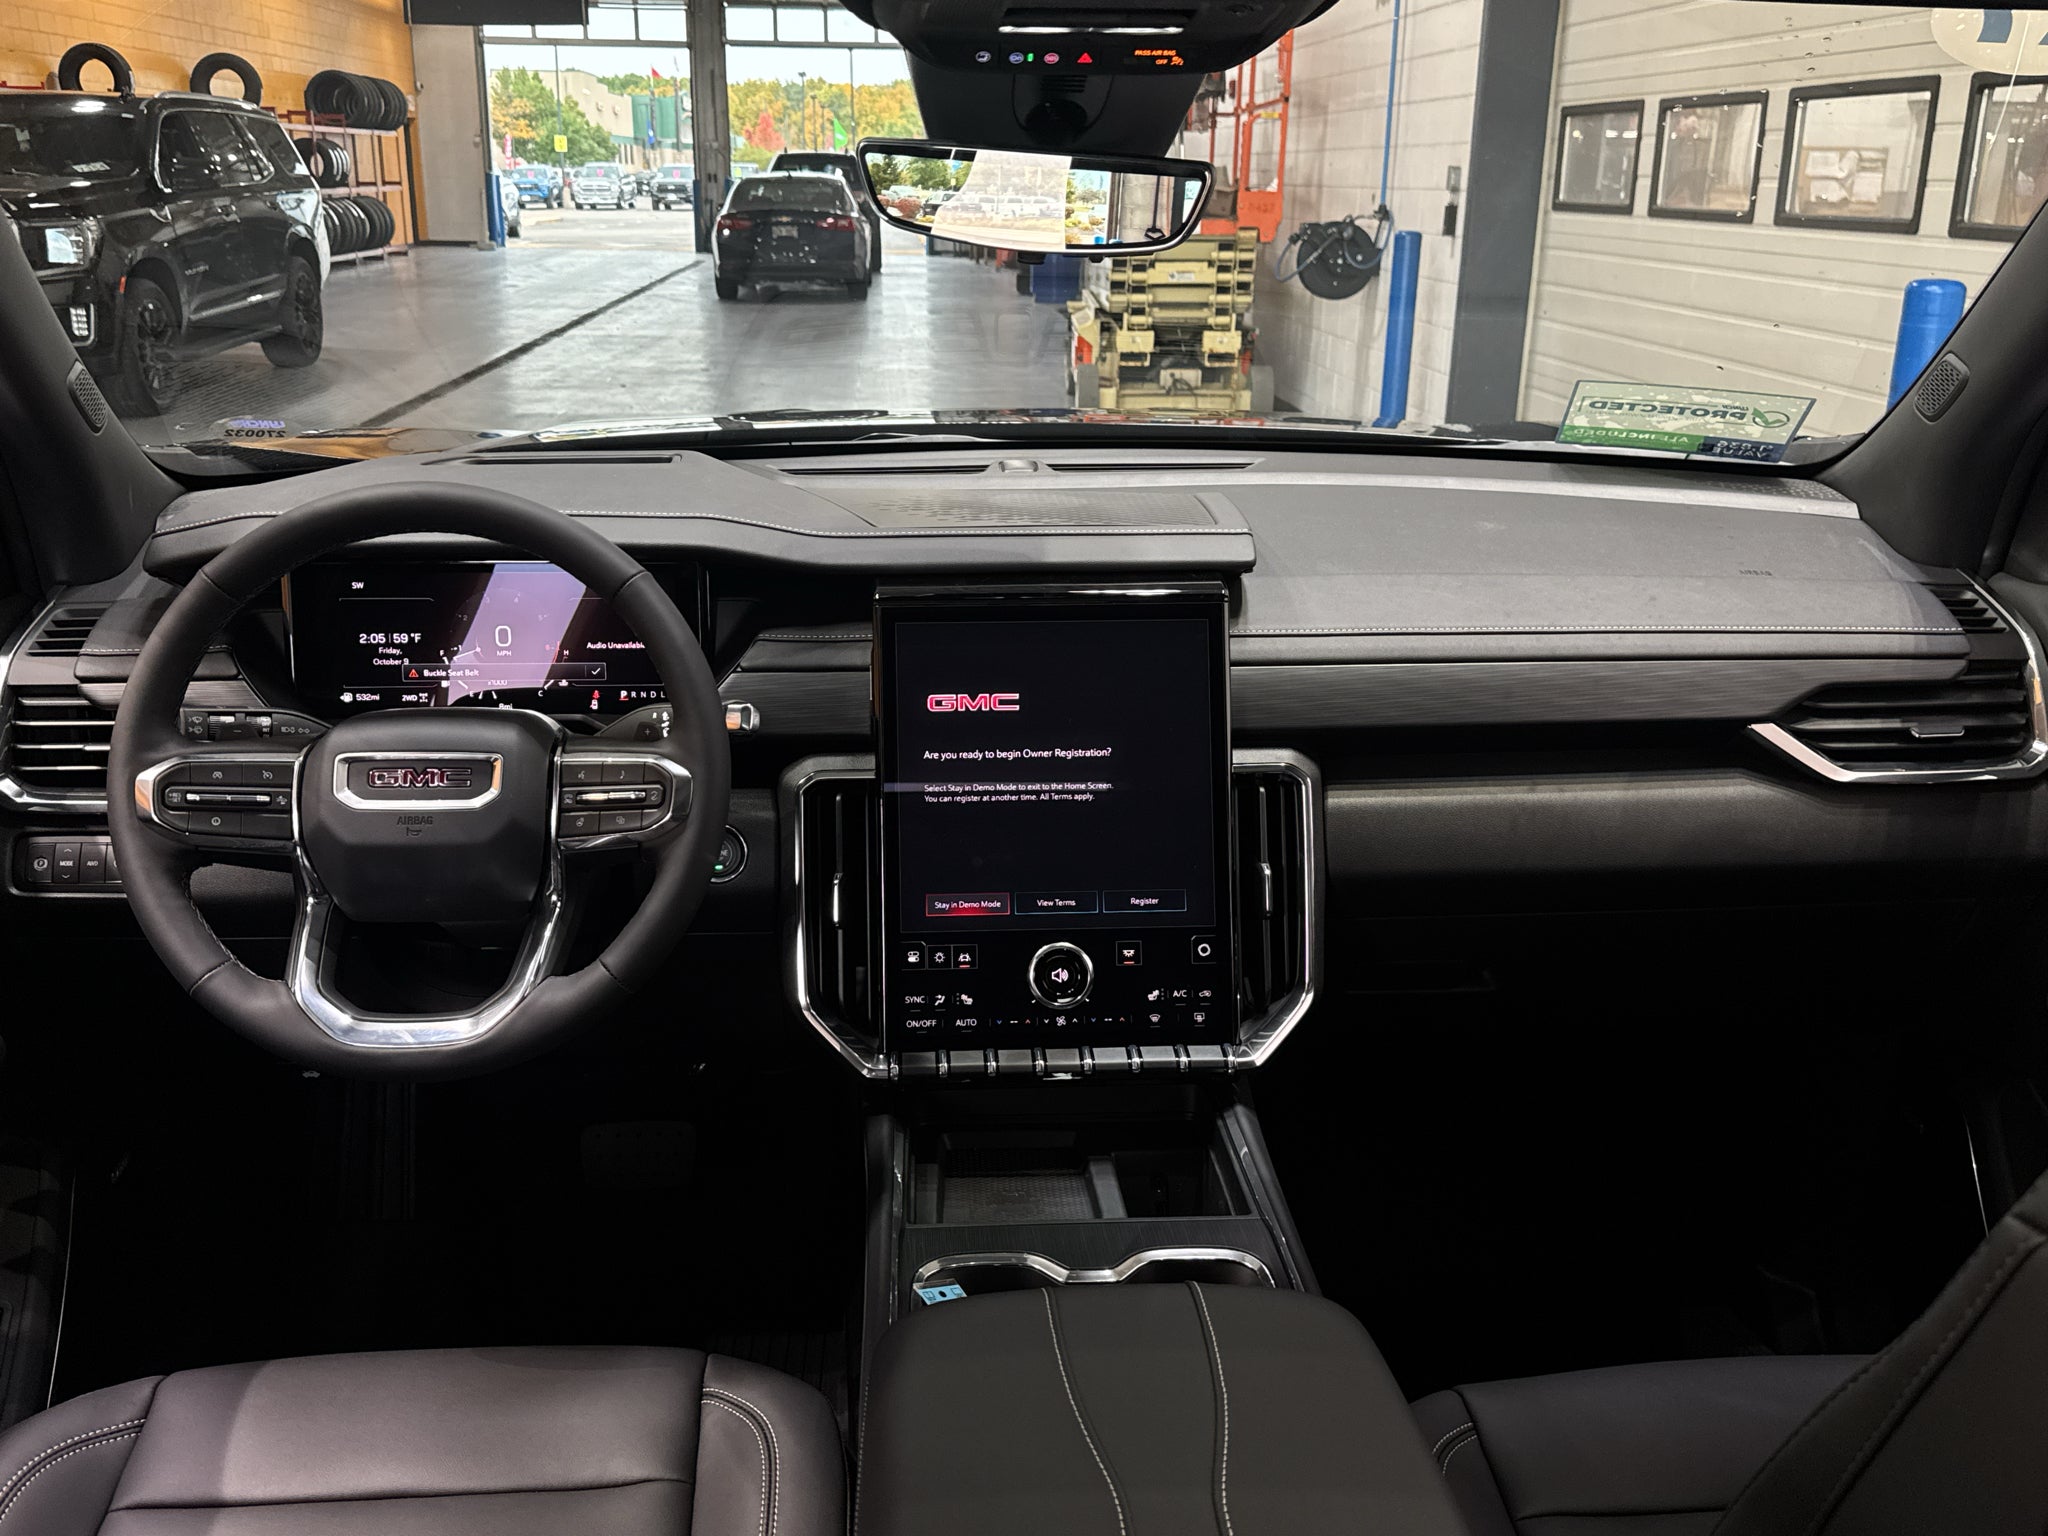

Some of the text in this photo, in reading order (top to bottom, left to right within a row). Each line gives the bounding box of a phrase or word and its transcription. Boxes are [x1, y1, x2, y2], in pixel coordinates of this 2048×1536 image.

[351, 581, 365, 590] SW
[359, 633, 386, 644] 2:05
[392, 633, 409, 644] 59
[494, 625, 512, 647] 0
[586, 641, 607, 649] Audio
[372, 658, 402, 666] October
[423, 669, 480, 677] Buckle Seat Belt
[355, 693, 380, 701] 532mi
[620, 690, 628, 698] P
[927, 693, 1020, 712] GMC
[923, 748, 1112, 761] Are you ready to begin Owner Registration?
[369, 768, 472, 788] GMC
[924, 785, 947, 793] Select
[948, 785, 963, 793] Stay
[973, 784, 995, 792] Demo
[1087, 782, 1114, 790] Screen.
[924, 795, 938, 803] You
[954, 795, 981, 803] register
[1050, 793, 1072, 801] Terms
[1074, 793, 1095, 802] apply.
[396, 816, 434, 826] AIRBAG
[934, 901, 950, 911] Stay
[958, 901, 980, 909] Demo
[981, 900, 1001, 908] Mode
[1037, 899, 1076, 907] View Terms
[1130, 897, 1159, 906] Register
[1172, 989, 1188, 998] A/C
[904, 995, 926, 1004] SYNC
[906, 1020, 937, 1028] ON/OFF
[955, 1018, 977, 1027] AUTO
